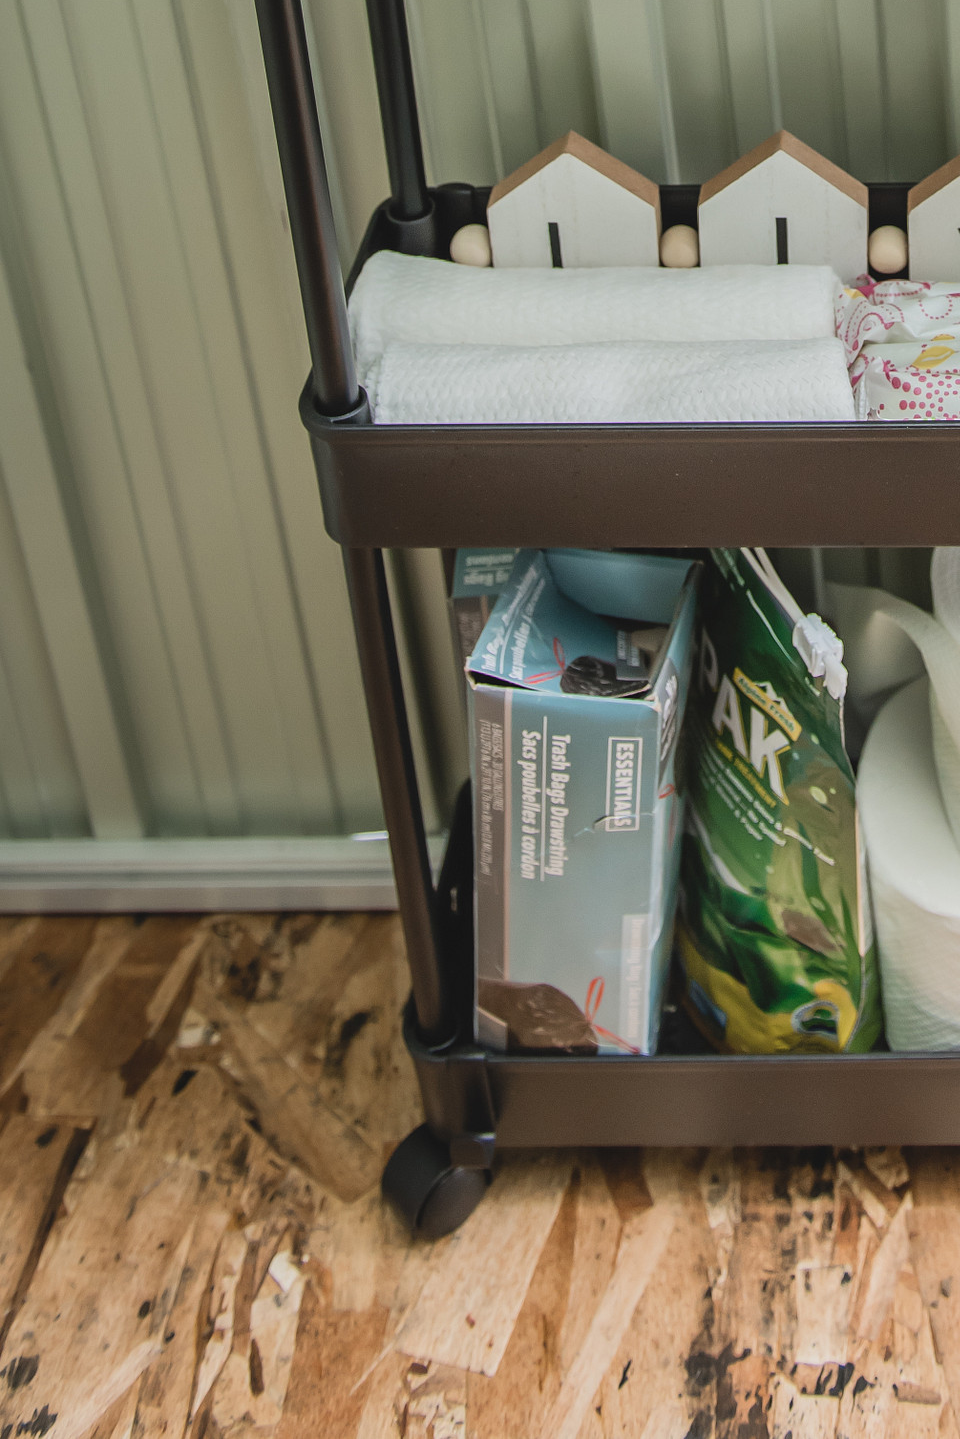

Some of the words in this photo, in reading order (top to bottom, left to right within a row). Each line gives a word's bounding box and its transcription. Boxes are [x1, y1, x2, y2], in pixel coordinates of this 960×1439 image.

[521, 730, 542, 760] Sacs
[551, 734, 571, 771] Trash
[516, 760, 541, 825] poubelles
[545, 772, 570, 805] Bags
[613, 742, 635, 828] ESSENTIALS
[520, 836, 540, 880] cordon
[543, 806, 569, 876] Drawstring
